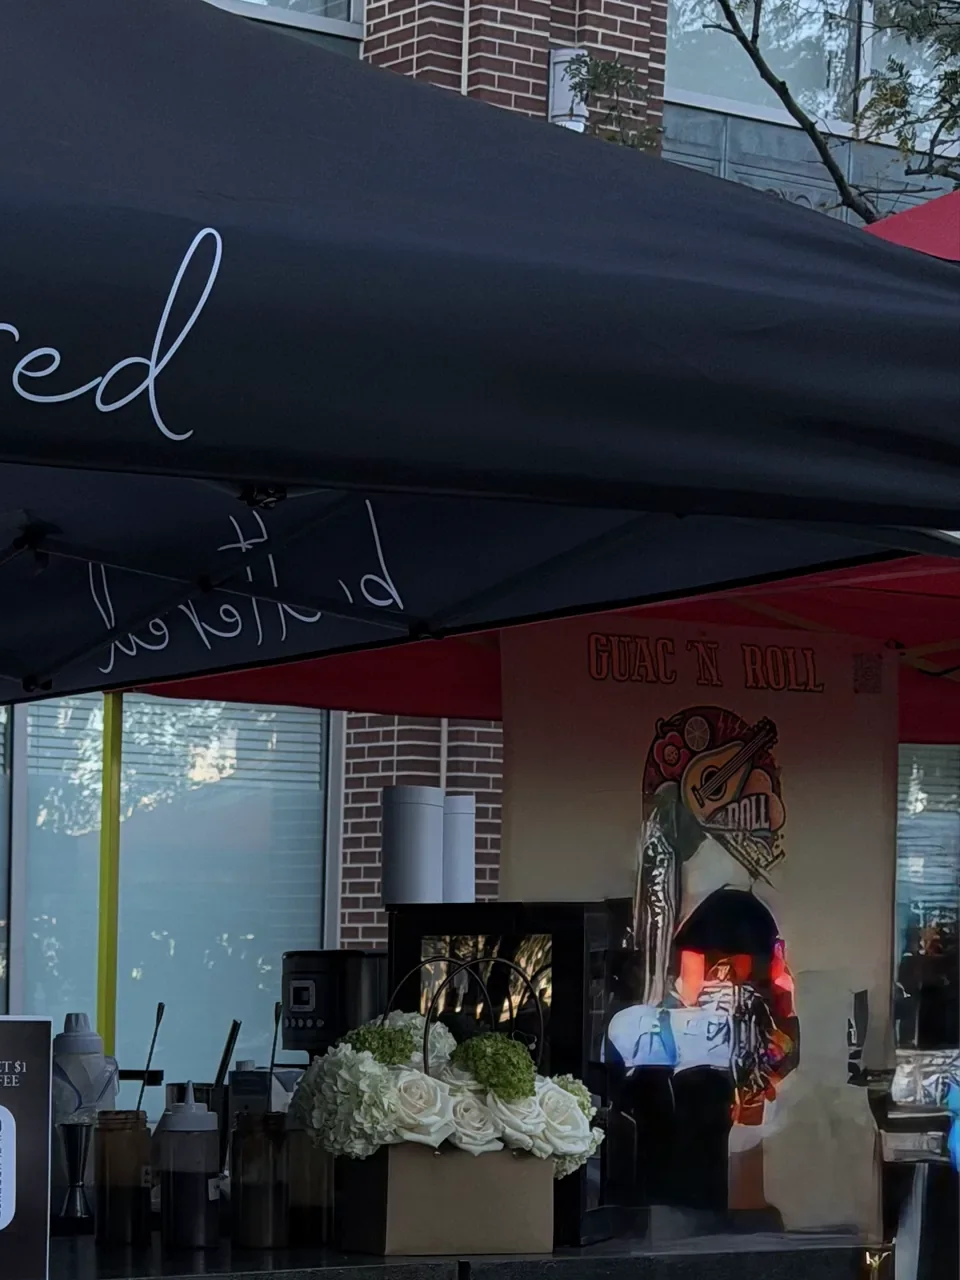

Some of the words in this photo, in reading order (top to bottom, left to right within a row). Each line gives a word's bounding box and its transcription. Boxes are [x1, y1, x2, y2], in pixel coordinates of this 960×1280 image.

[588, 632, 677, 685] GUAC
[741, 643, 824, 693] ROLL
[14, 1060, 27, 1074] $1
